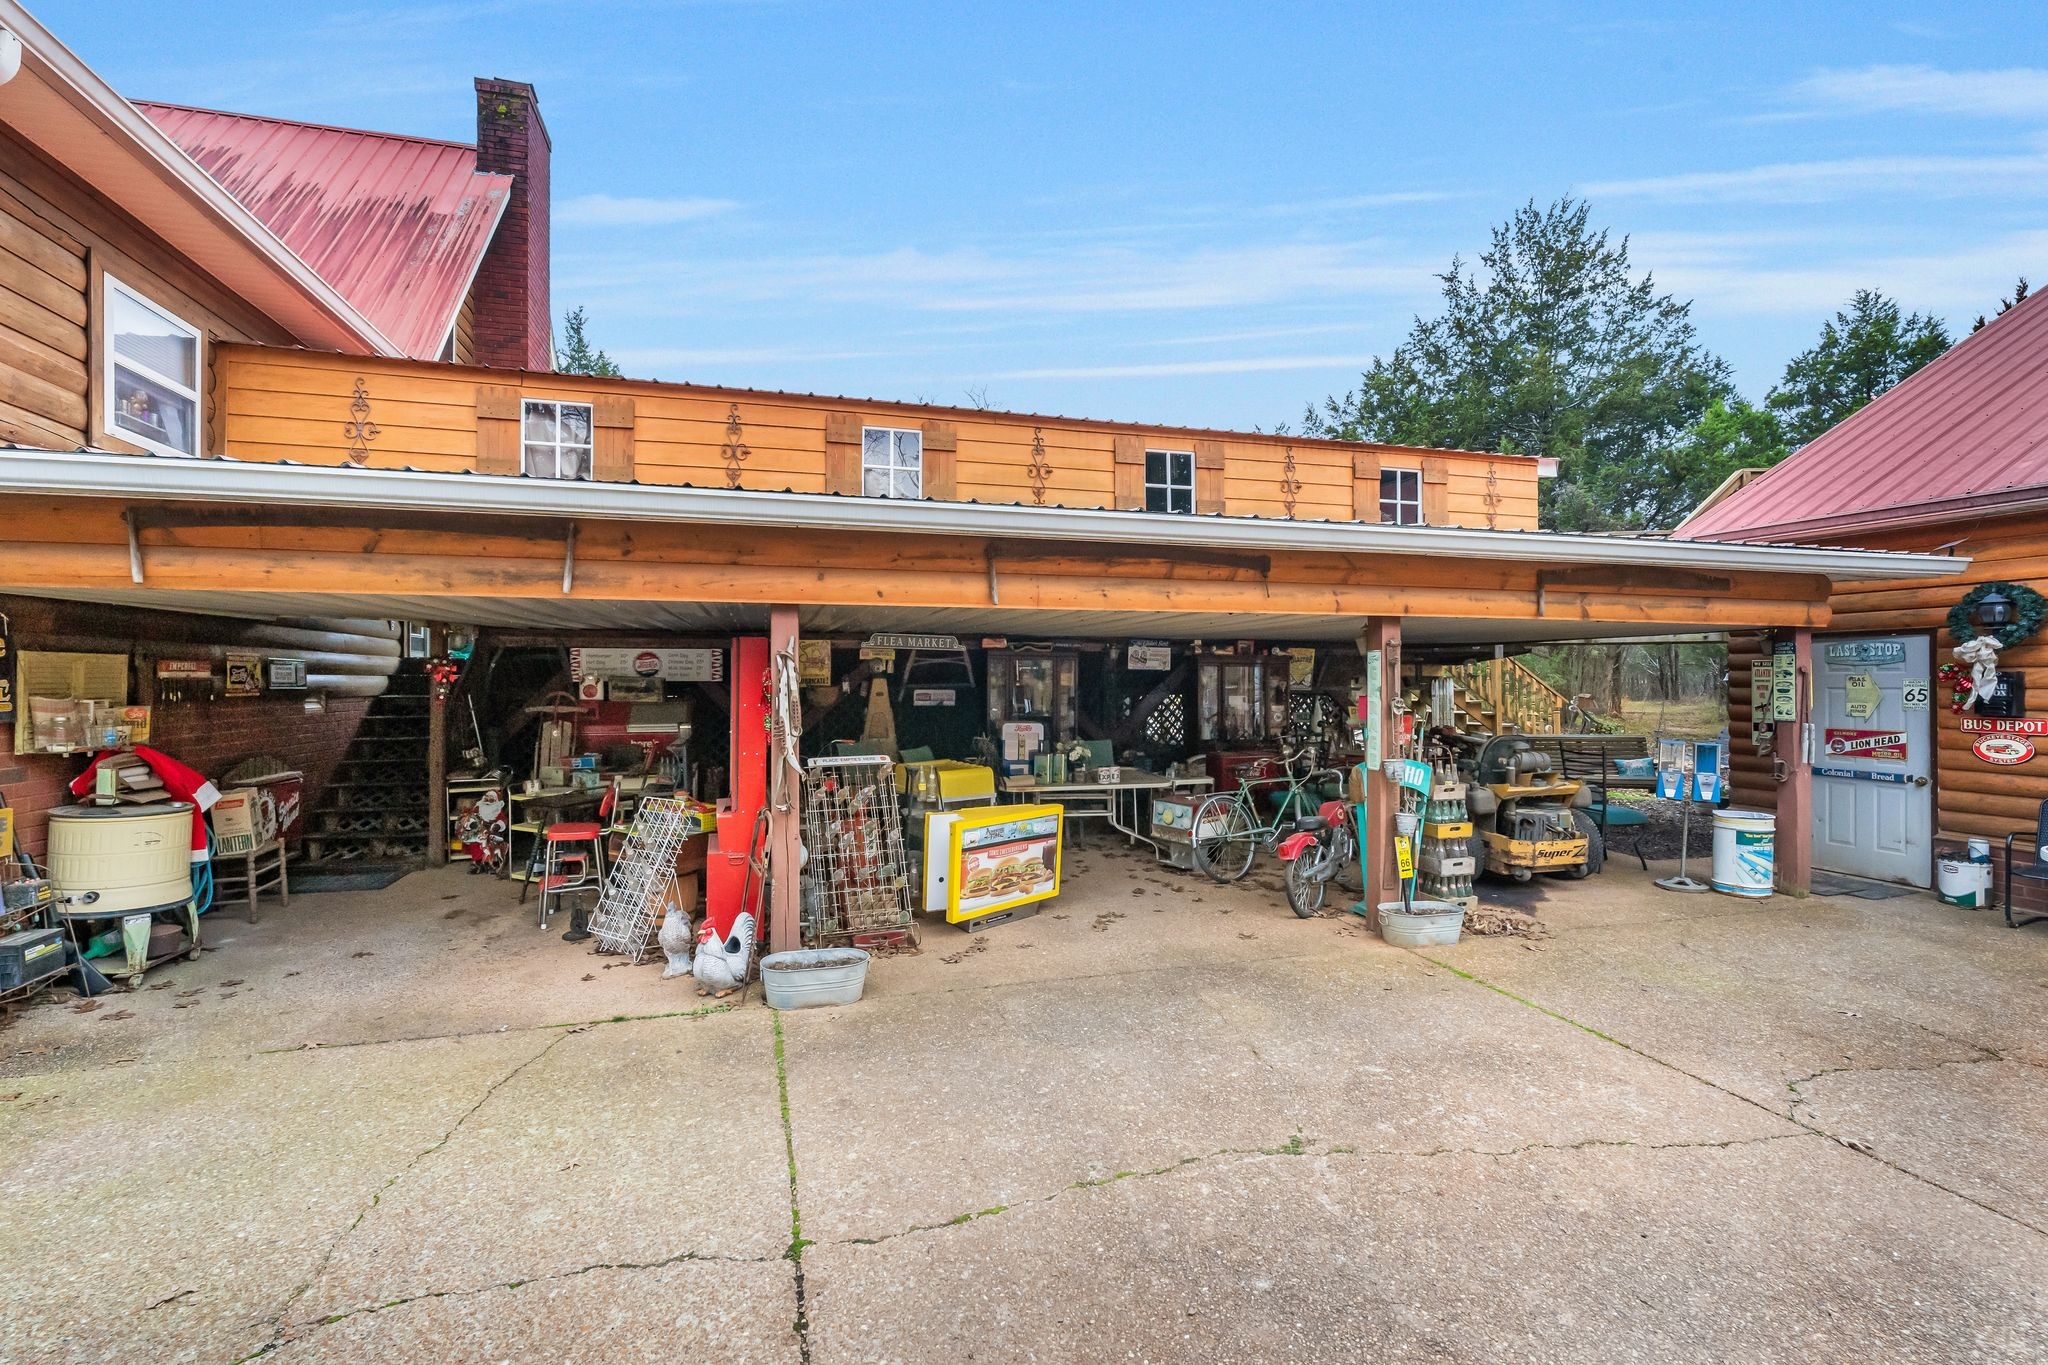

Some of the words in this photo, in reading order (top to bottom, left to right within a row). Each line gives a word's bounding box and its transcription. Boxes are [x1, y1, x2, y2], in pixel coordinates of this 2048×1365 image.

[877, 637, 903, 646] FLEA
[907, 638, 952, 648] MARKET
[1829, 644, 1858, 657] LAST
[1869, 643, 1901, 656] STOP
[800, 676, 829, 686] UBRICATE!
[1904, 688, 1928, 702] 65
[1963, 719, 1992, 730] BUS
[1996, 720, 2044, 733] DEPOT
[1850, 740, 1871, 750] LION
[1873, 735, 1901, 747] HEAD
[1975, 734, 2004, 747] BUCKEYE
[2006, 734, 2032, 750] STAGES
[1821, 768, 1854, 778] Colonial
[1871, 772, 1895, 781] Bread
[217, 833, 254, 854] LANTERN
[1537, 849, 1574, 859] Super
[1571, 844, 1587, 858] Z
[1400, 858, 1411, 868] 66
